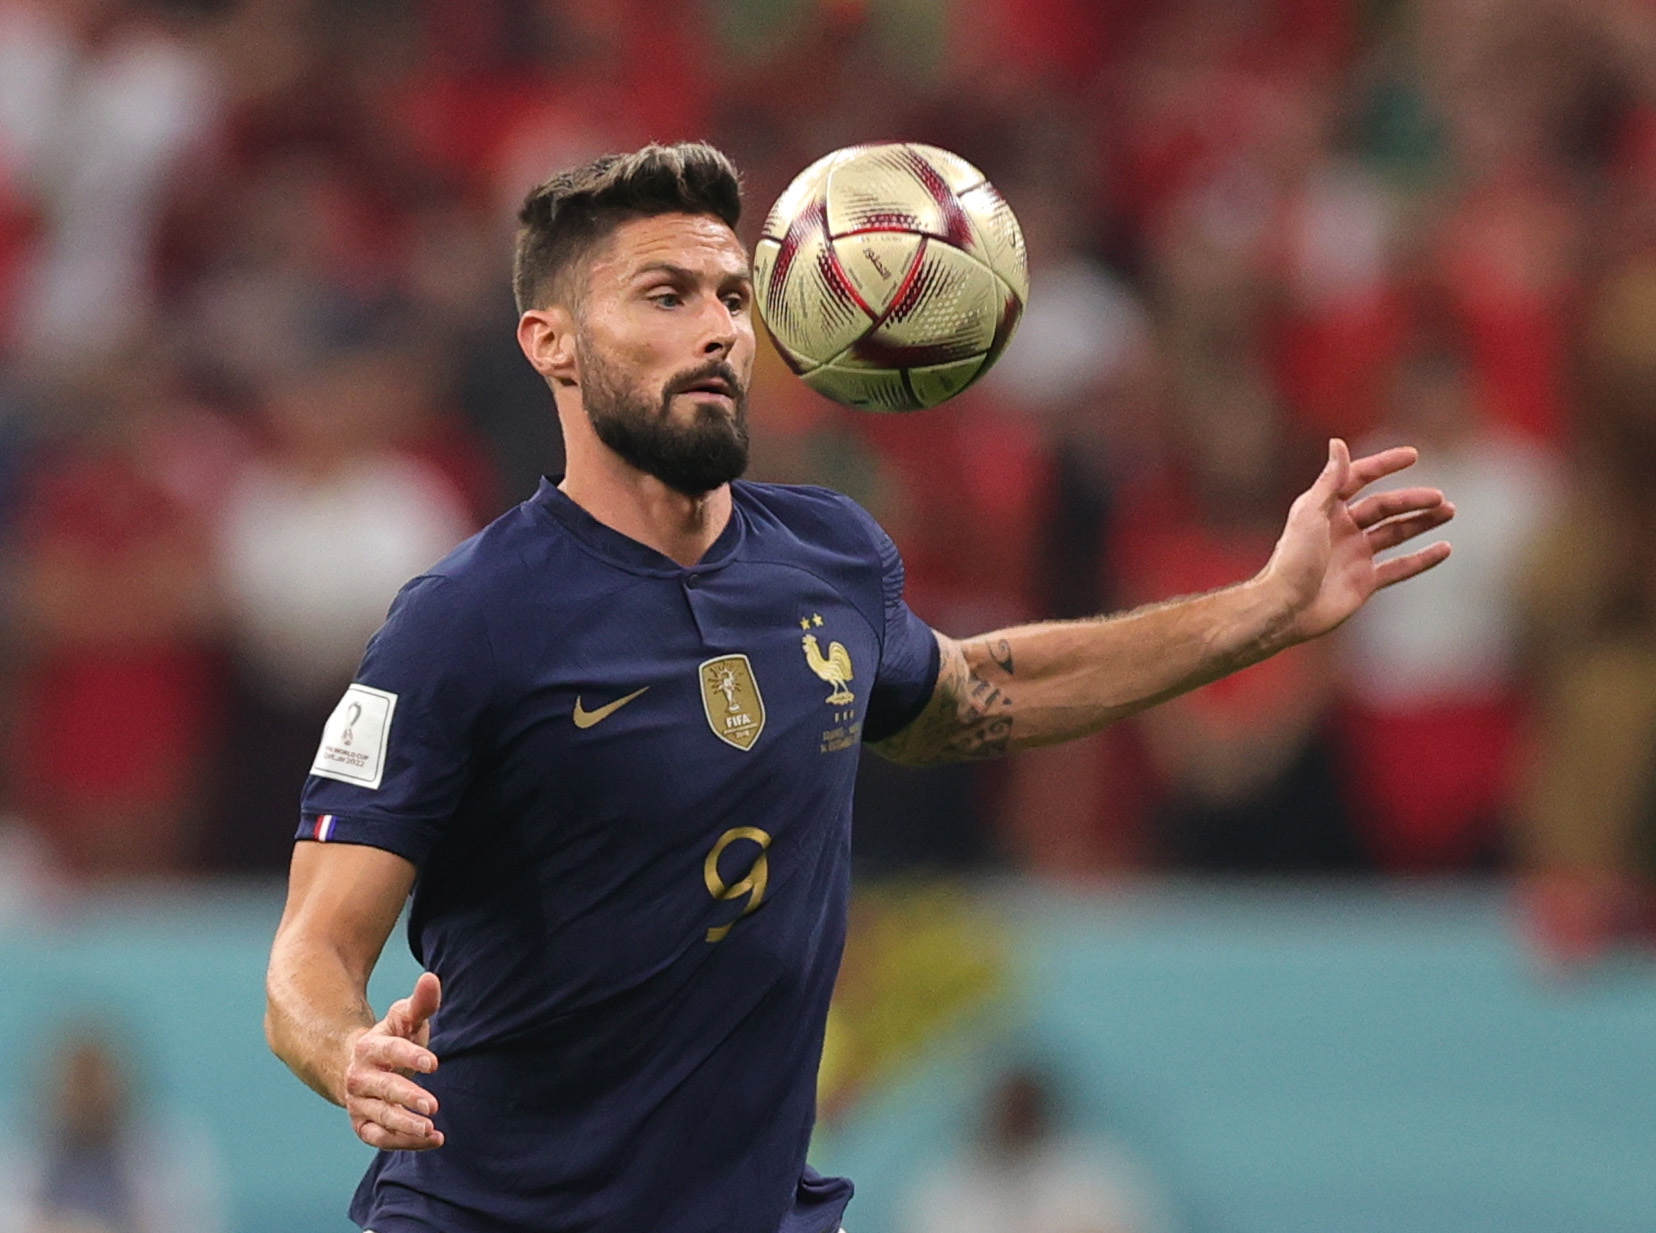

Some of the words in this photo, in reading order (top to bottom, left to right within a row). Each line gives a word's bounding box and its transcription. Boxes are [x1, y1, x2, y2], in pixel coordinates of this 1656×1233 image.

[726, 713, 751, 728] FIFA
[346, 757, 365, 767] 2022
[703, 826, 772, 943] 9
